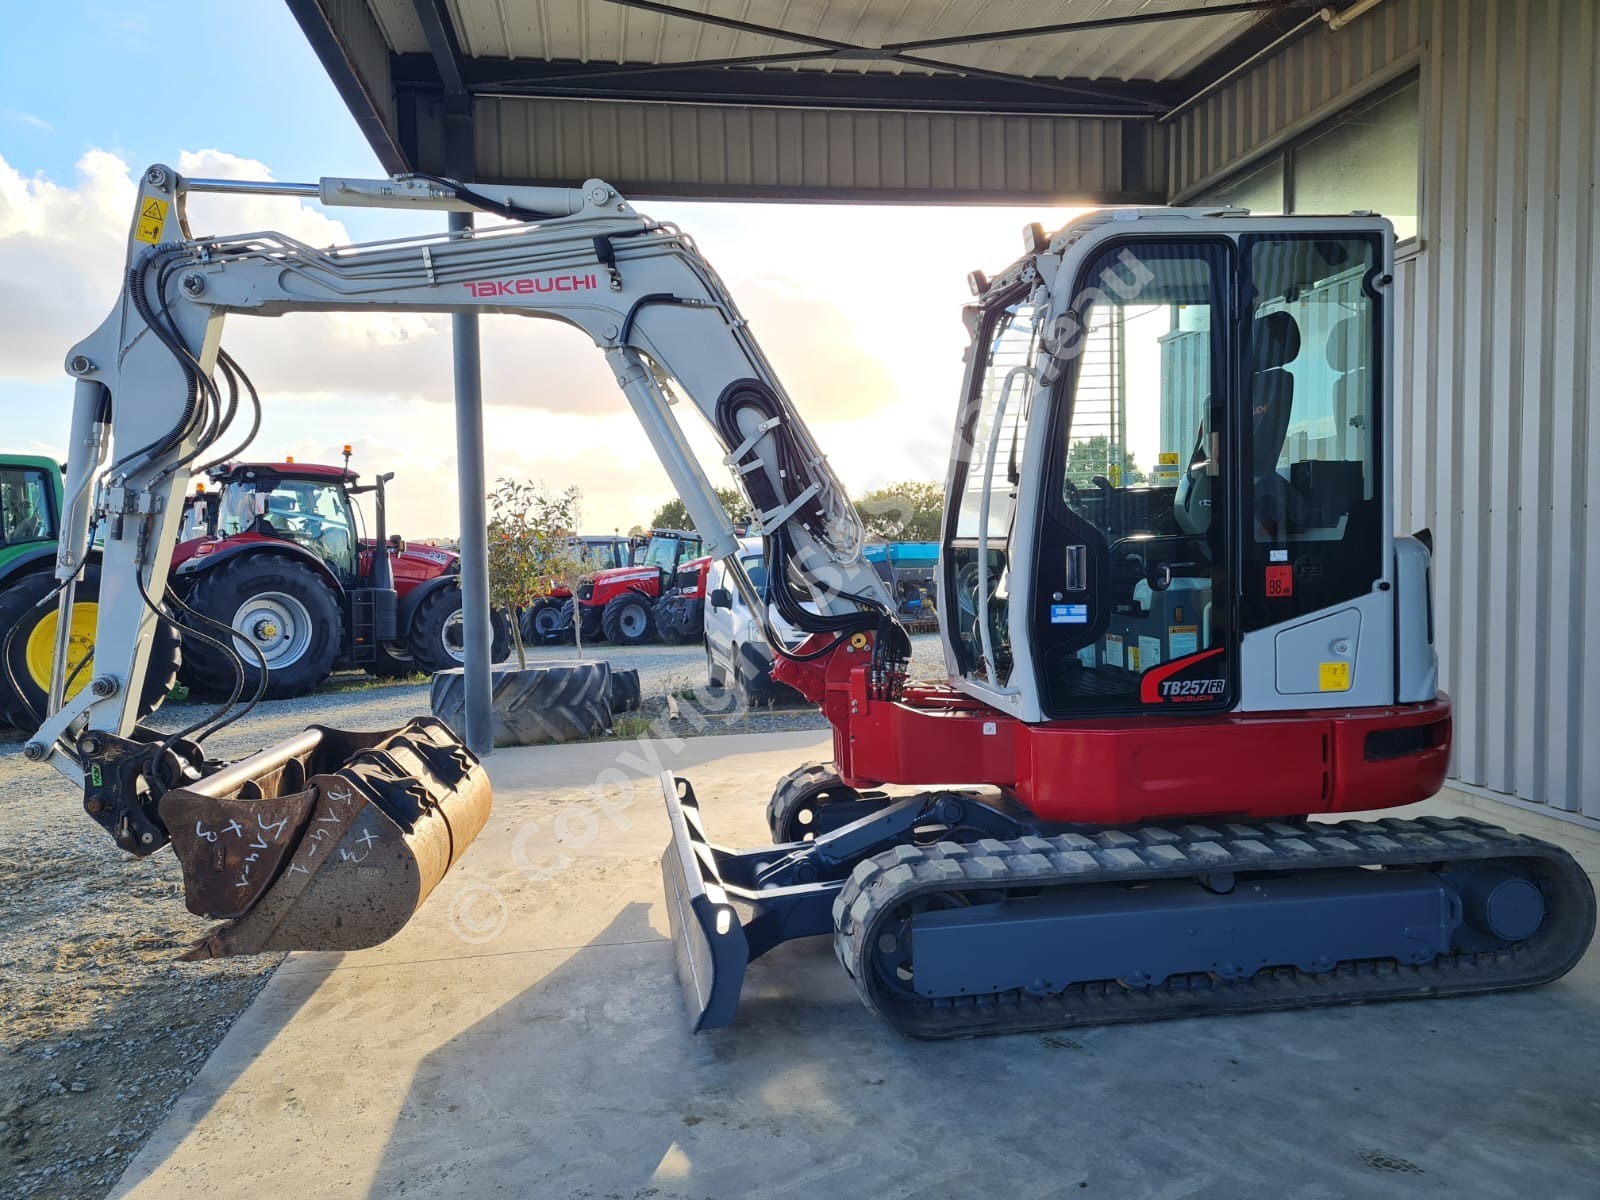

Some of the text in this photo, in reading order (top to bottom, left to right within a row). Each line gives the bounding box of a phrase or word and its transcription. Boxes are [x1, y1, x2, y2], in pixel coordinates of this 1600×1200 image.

[463, 274, 598, 298] TAKEUCHI
[428, 551, 448, 561] 240
[1269, 579, 1282, 594] 98
